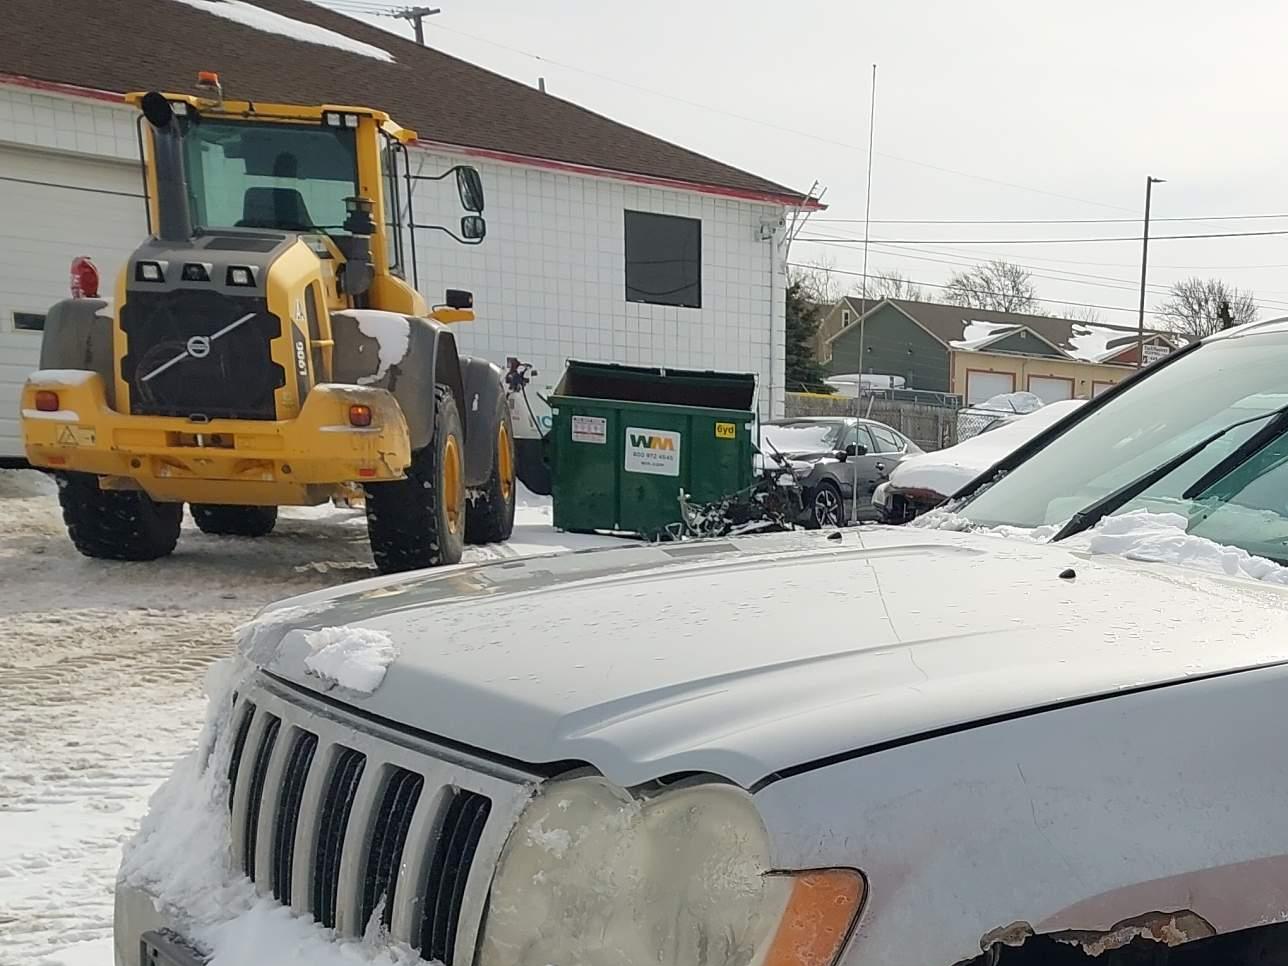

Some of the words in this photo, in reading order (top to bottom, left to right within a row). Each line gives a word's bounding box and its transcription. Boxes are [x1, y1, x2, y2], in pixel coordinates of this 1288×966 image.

[296, 342, 307, 375] L90G
[717, 424, 734, 435] 6yd
[630, 434, 674, 450] WM
